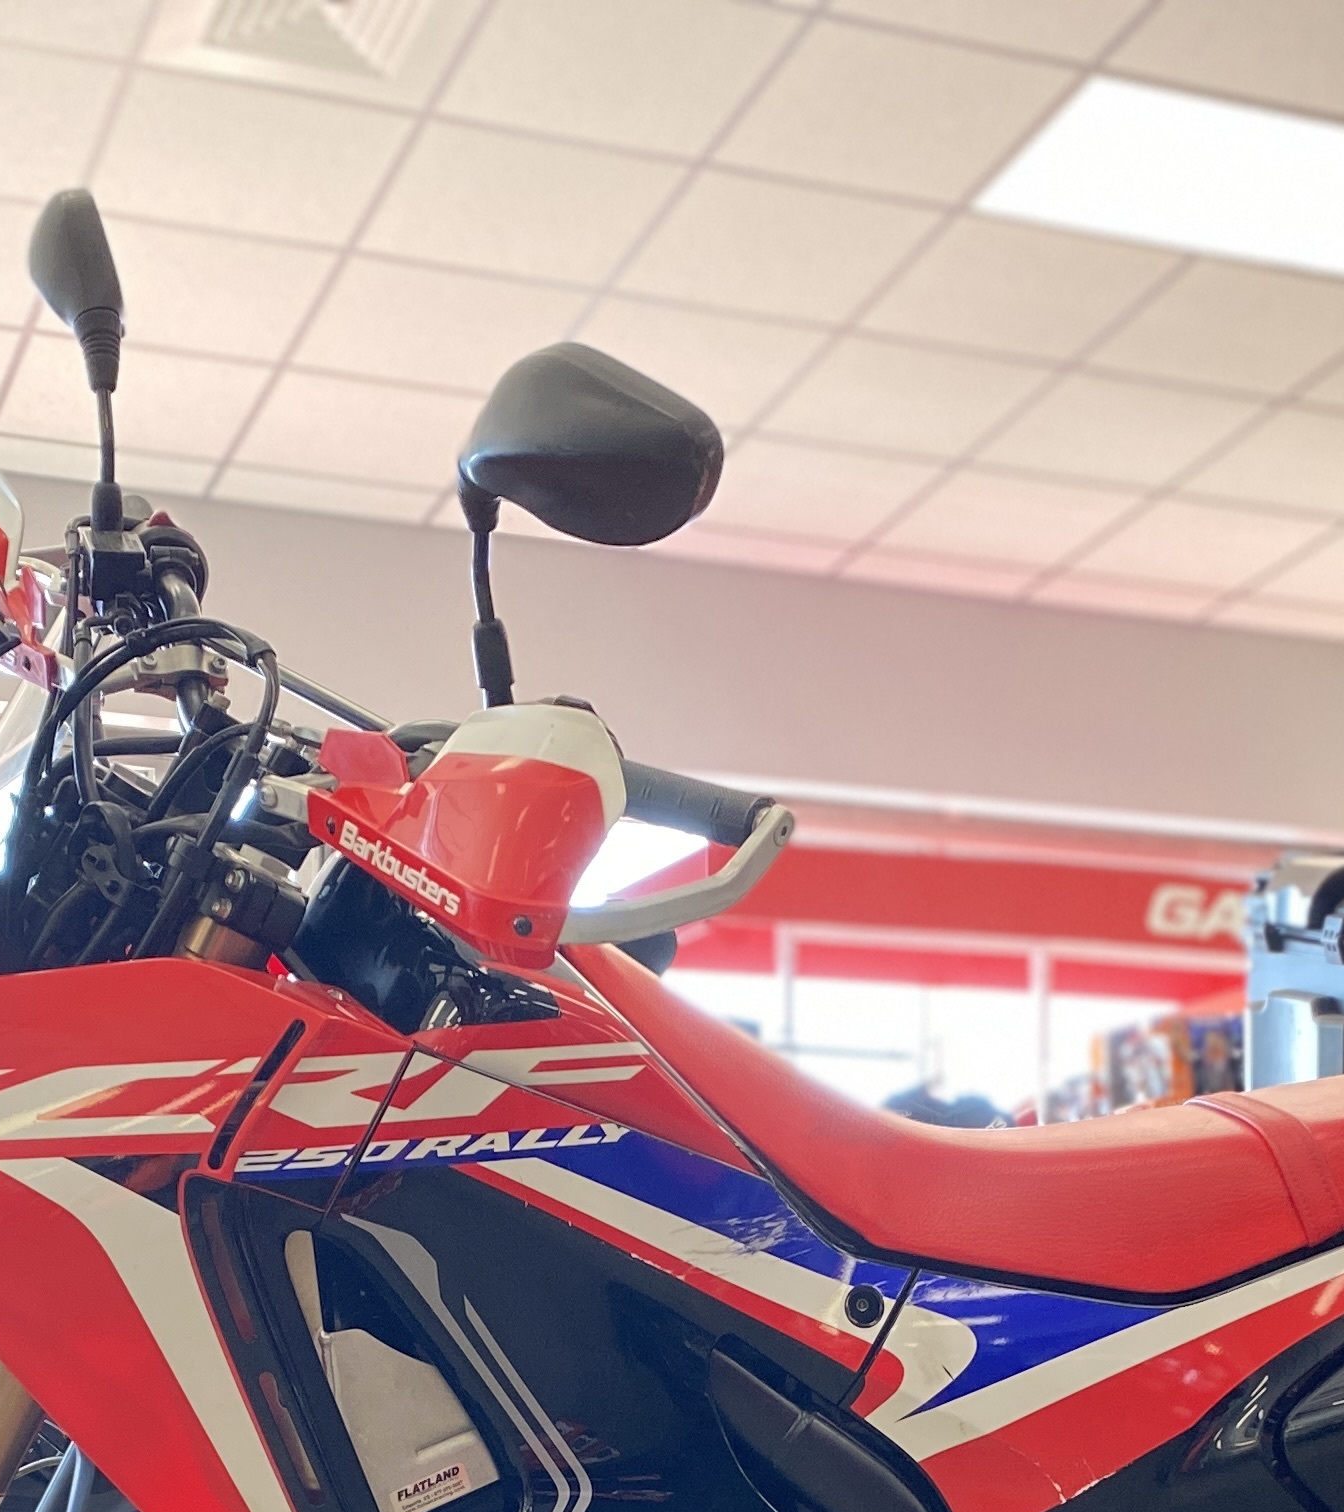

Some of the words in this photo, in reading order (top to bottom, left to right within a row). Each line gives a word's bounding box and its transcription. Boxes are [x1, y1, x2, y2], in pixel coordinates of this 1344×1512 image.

[339, 820, 461, 916] Barkbusters
[234, 1138, 392, 1173] 250
[404, 1122, 632, 1161] RALLY
[397, 1465, 460, 1502] FLATLAND
